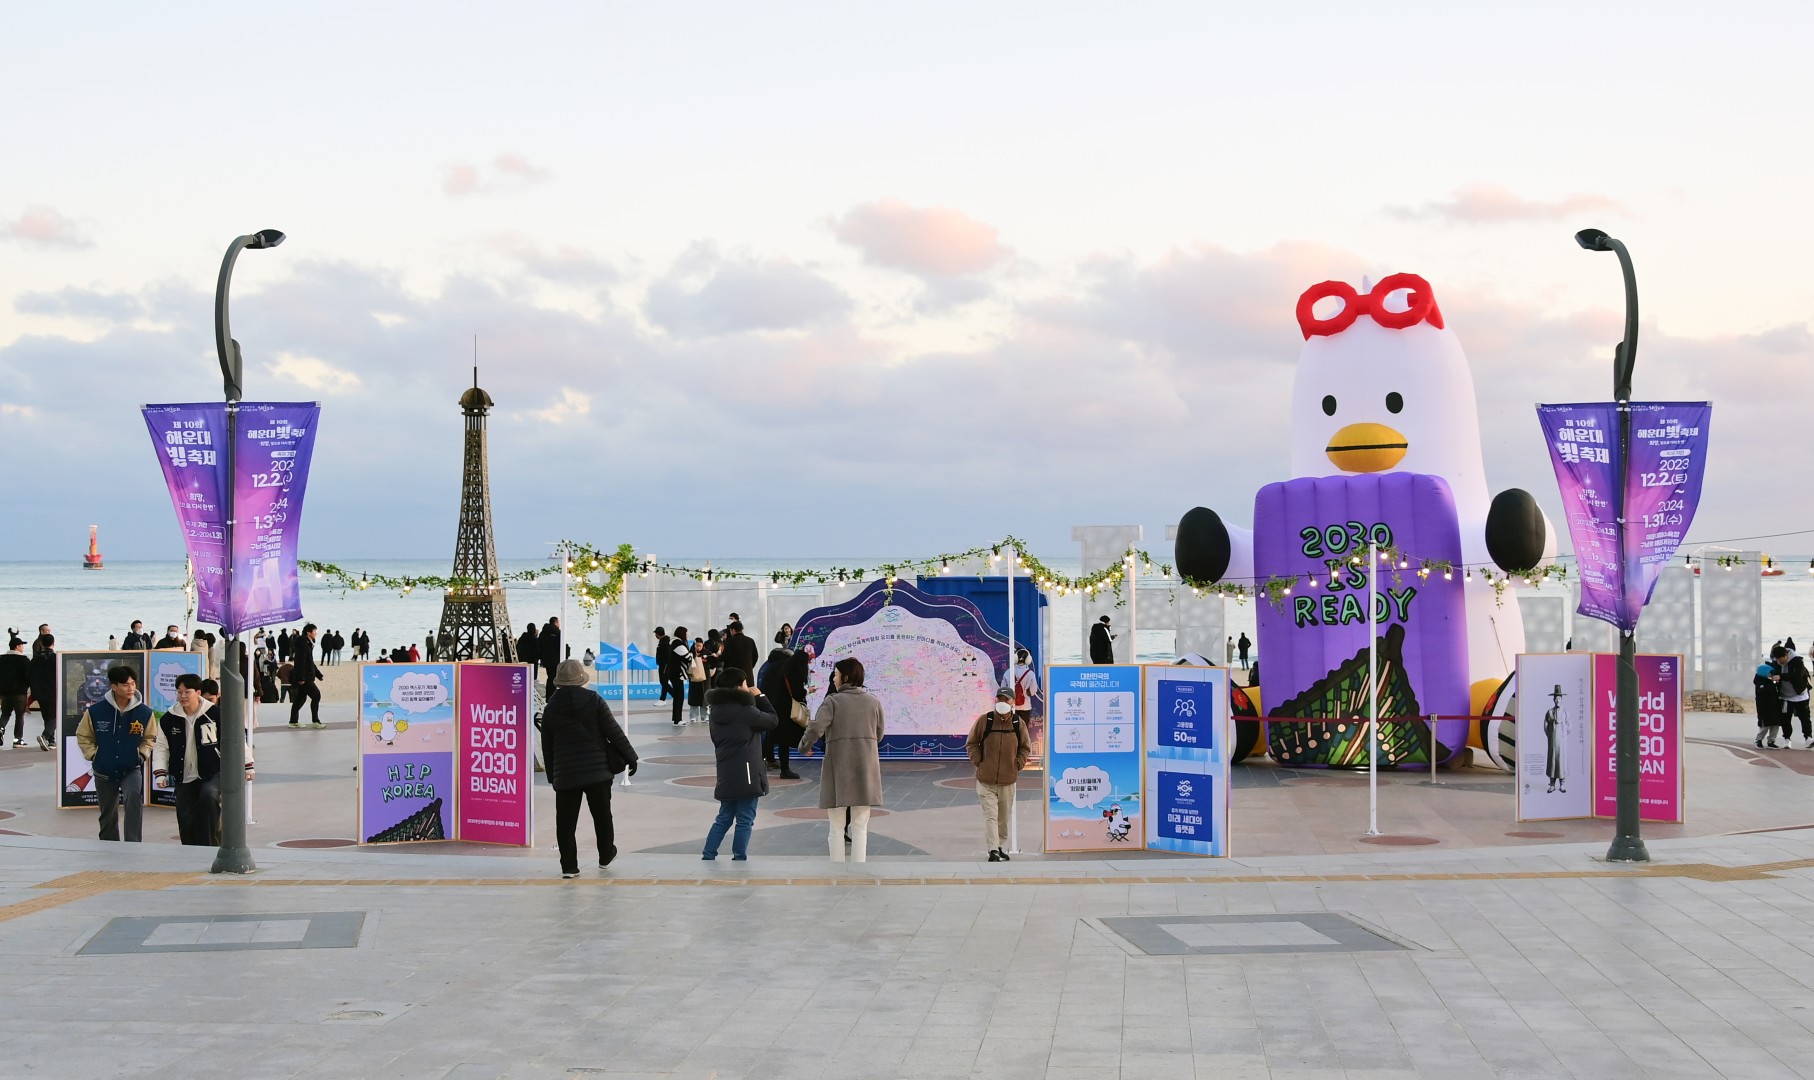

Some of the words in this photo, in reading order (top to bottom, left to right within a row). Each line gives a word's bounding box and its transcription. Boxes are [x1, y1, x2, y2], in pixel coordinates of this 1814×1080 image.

[165, 430, 212, 446] 해운대
[1558, 428, 1604, 444] 해운대
[1659, 458, 1690, 472] 2023
[1641, 472, 1688, 488] 12.2.(토)
[1657, 499, 1684, 513] 2024
[1299, 521, 1394, 560] 2030
[1324, 559, 1367, 592] IS
[1293, 586, 1418, 629] READY
[603, 689, 635, 697] #GSTR
[1608, 690, 1665, 711] rld
[470, 703, 517, 726] World
[1608, 712, 1665, 733] EPO
[200, 720, 219, 747] N
[471, 727, 517, 750] EXPO
[1608, 735, 1665, 757] 230
[387, 763, 432, 783] HIP
[470, 751, 517, 775] 2030
[381, 782, 435, 804] KOREA
[471, 776, 517, 796] BUSAN
[1167, 814, 1181, 823] 미래
